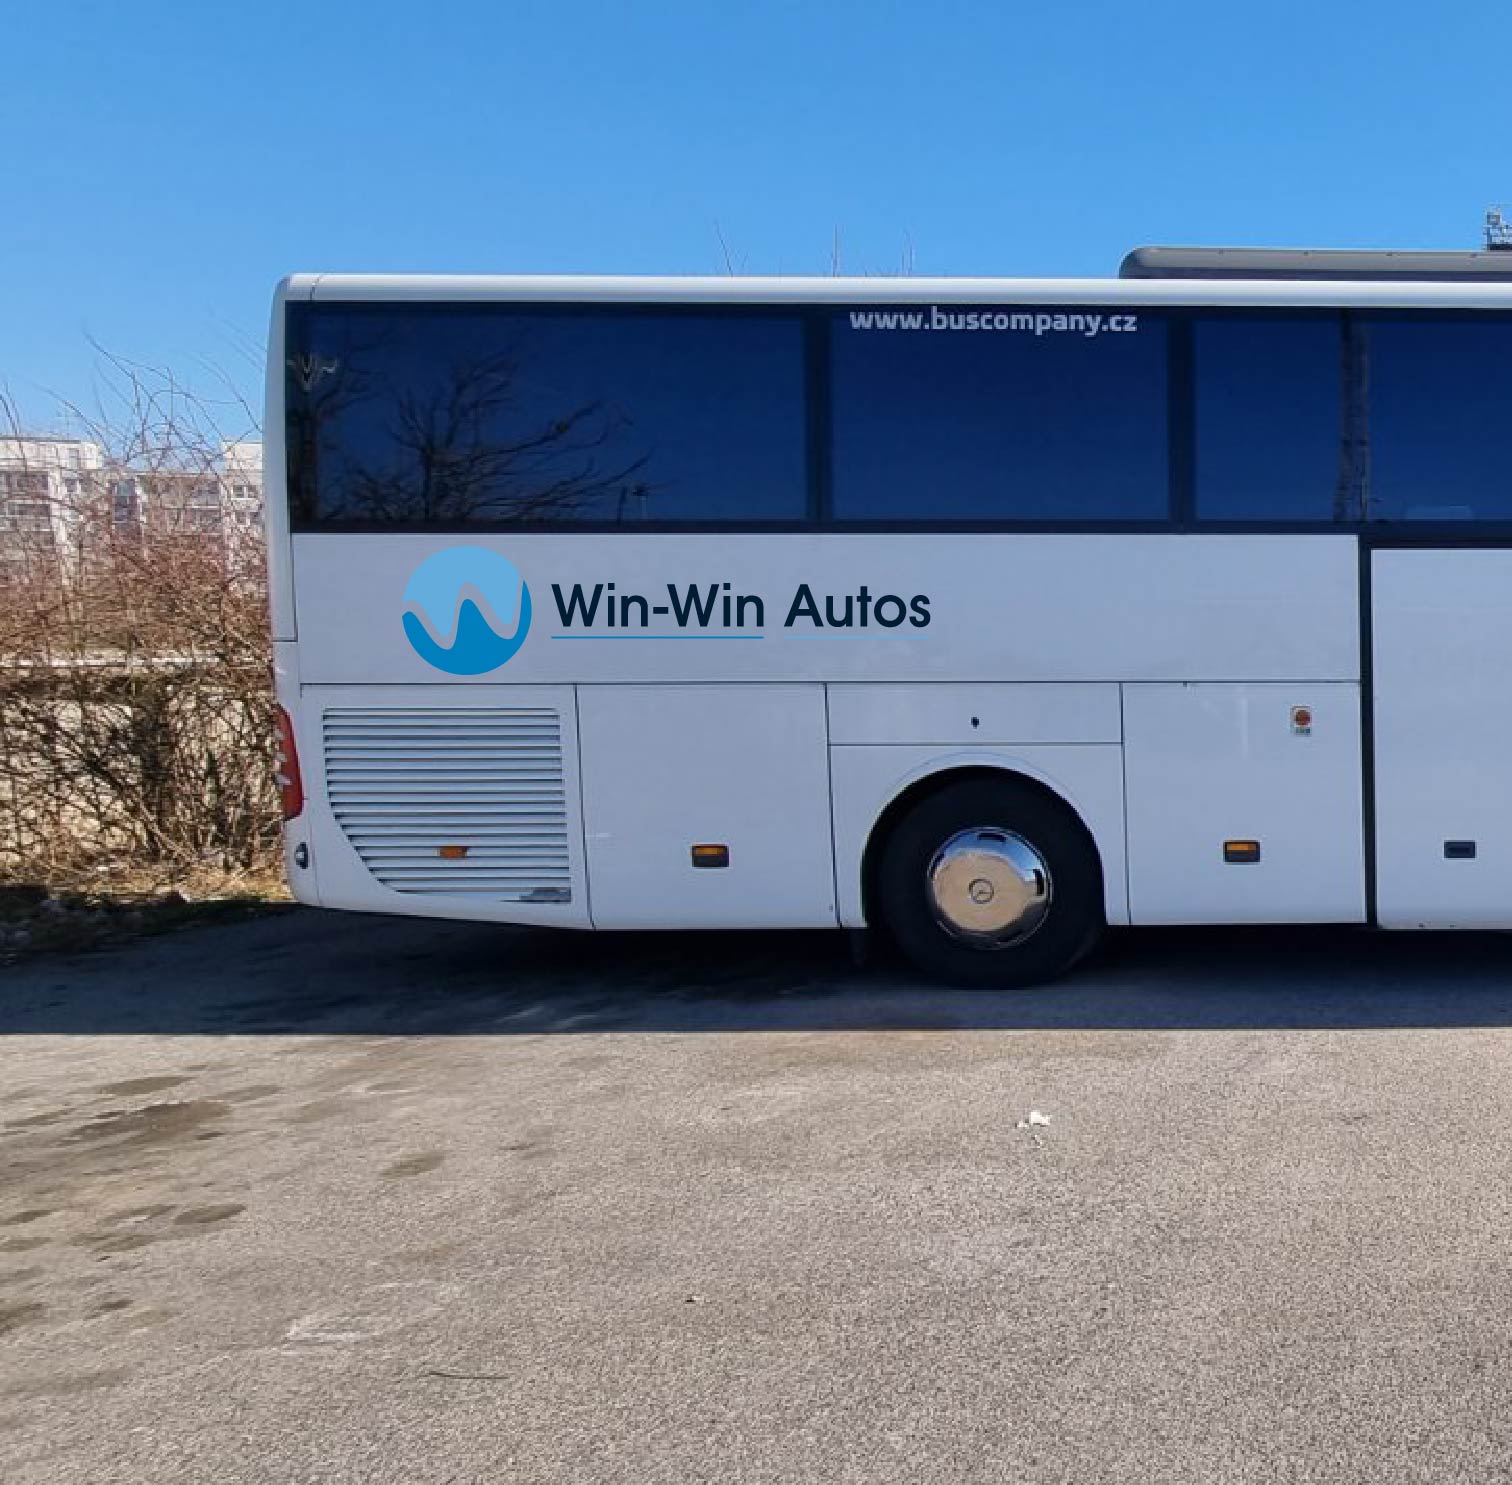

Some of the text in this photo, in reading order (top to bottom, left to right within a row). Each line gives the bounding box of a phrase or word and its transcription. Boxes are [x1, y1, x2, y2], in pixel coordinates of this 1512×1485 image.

[850, 306, 1137, 336] www.buscompany.cz
[551, 583, 930, 627] Win-Win Autos
